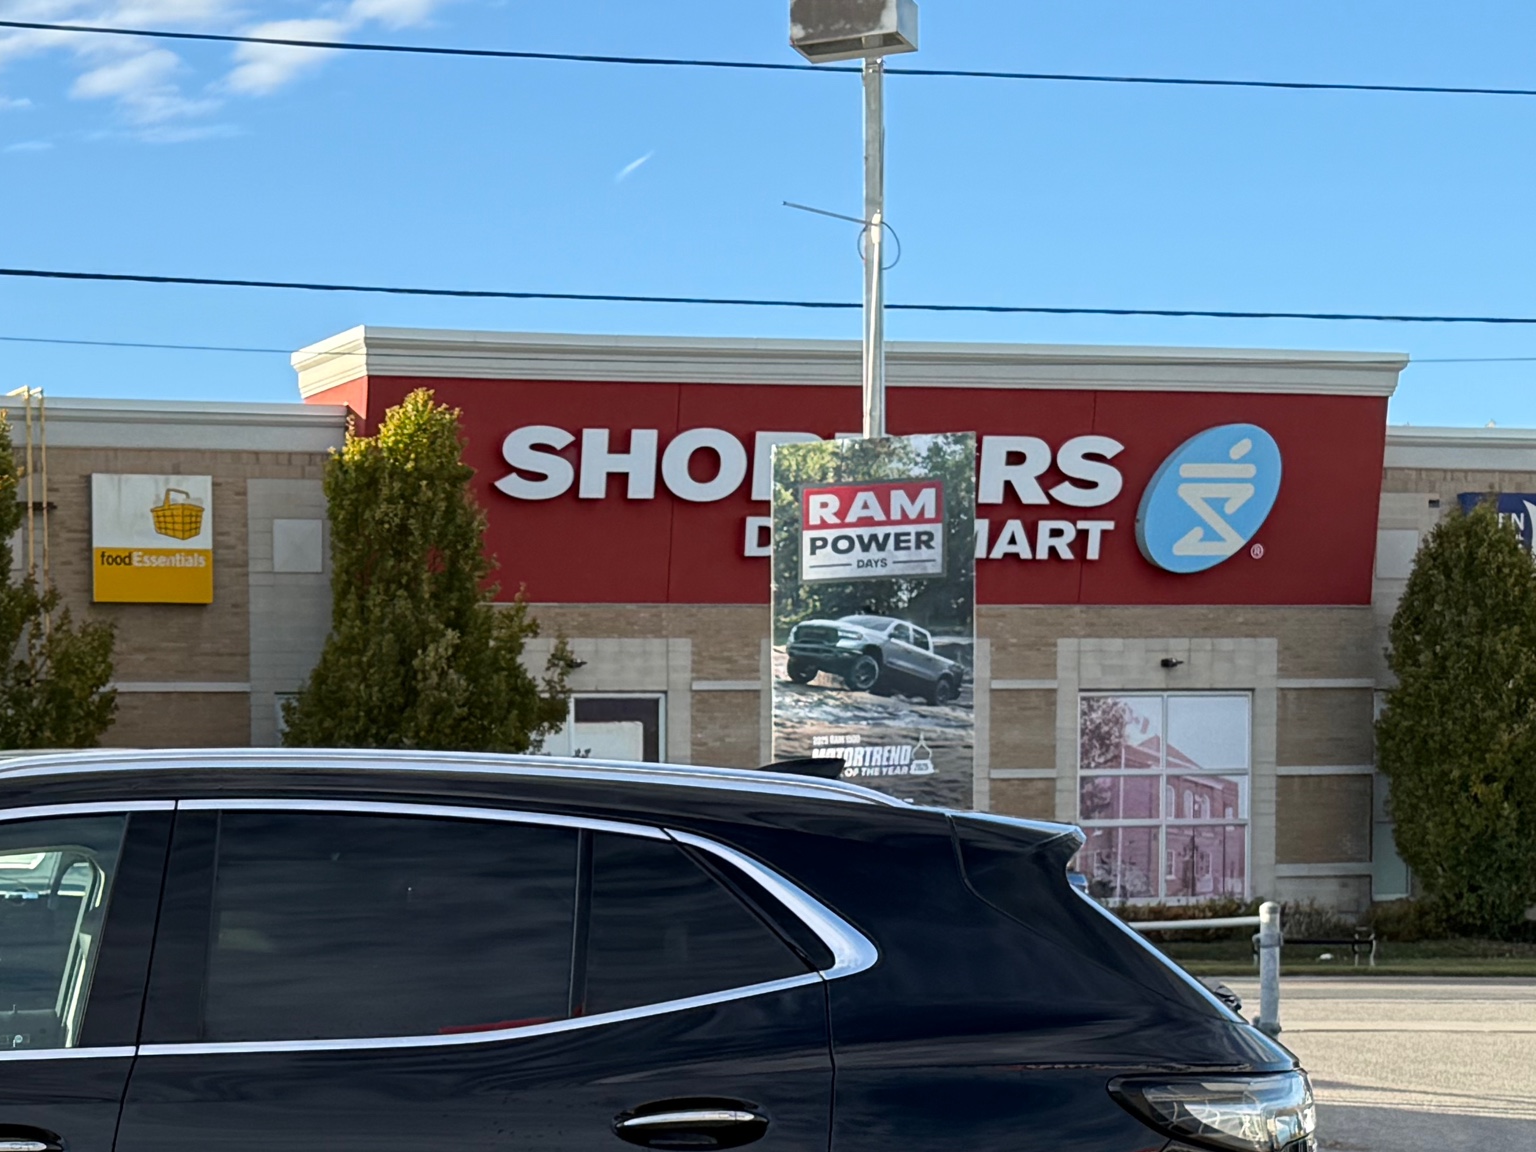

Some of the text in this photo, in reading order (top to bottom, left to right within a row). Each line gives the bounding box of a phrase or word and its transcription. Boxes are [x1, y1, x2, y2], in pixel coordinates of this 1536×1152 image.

[494, 425, 1125, 507] SHORS
[808, 487, 937, 526] RAM
[809, 530, 935, 556] POWER
[856, 557, 888, 569] DAYS
[860, 766, 881, 777] THE
[881, 765, 909, 776] YEAR
